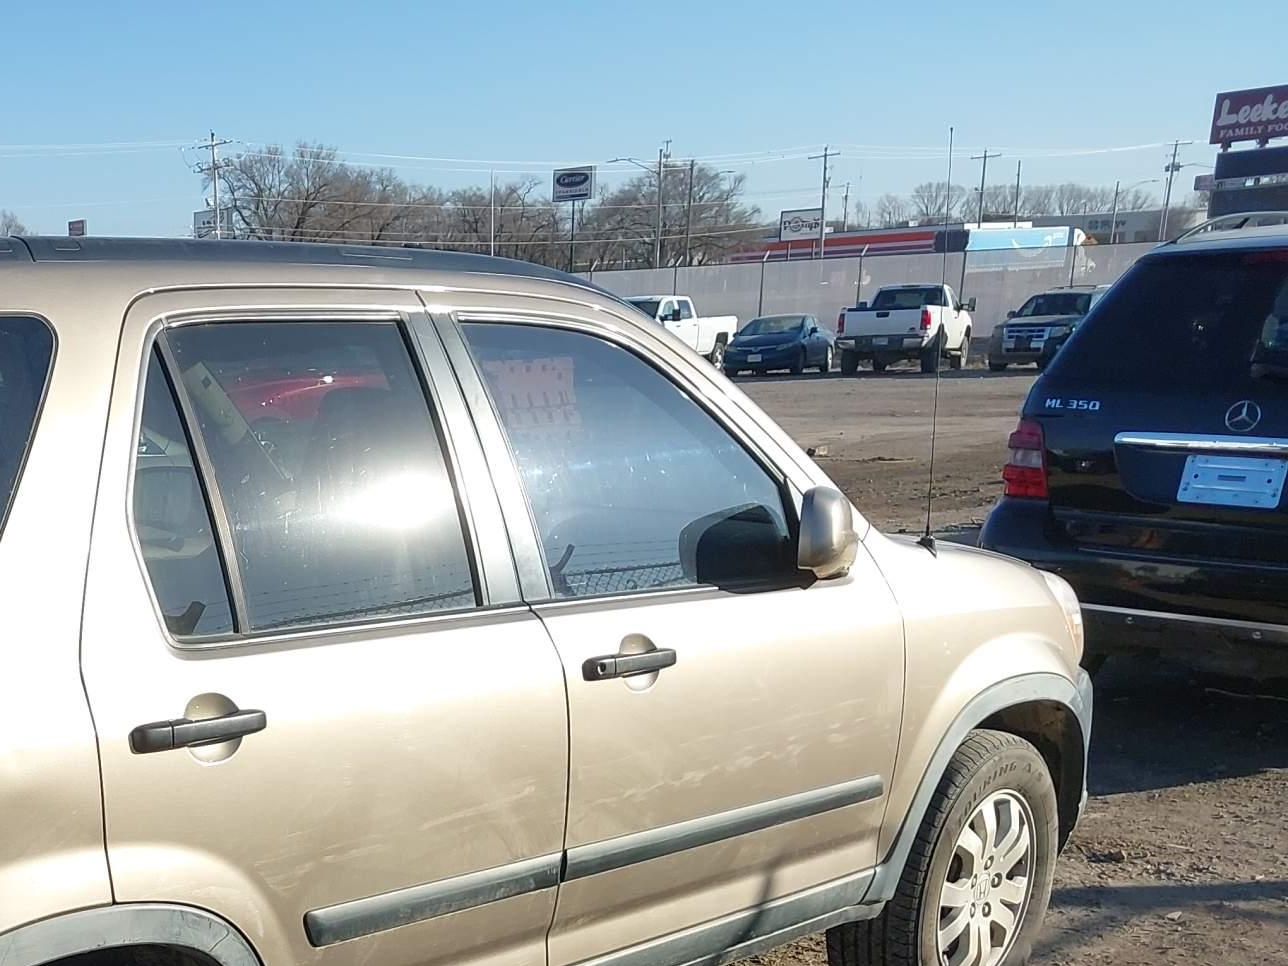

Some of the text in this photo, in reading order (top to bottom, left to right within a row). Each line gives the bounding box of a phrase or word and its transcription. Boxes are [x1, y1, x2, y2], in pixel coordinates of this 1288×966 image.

[1219, 125, 1264, 138] FAMILY
[1045, 398, 1100, 410] ML 350
